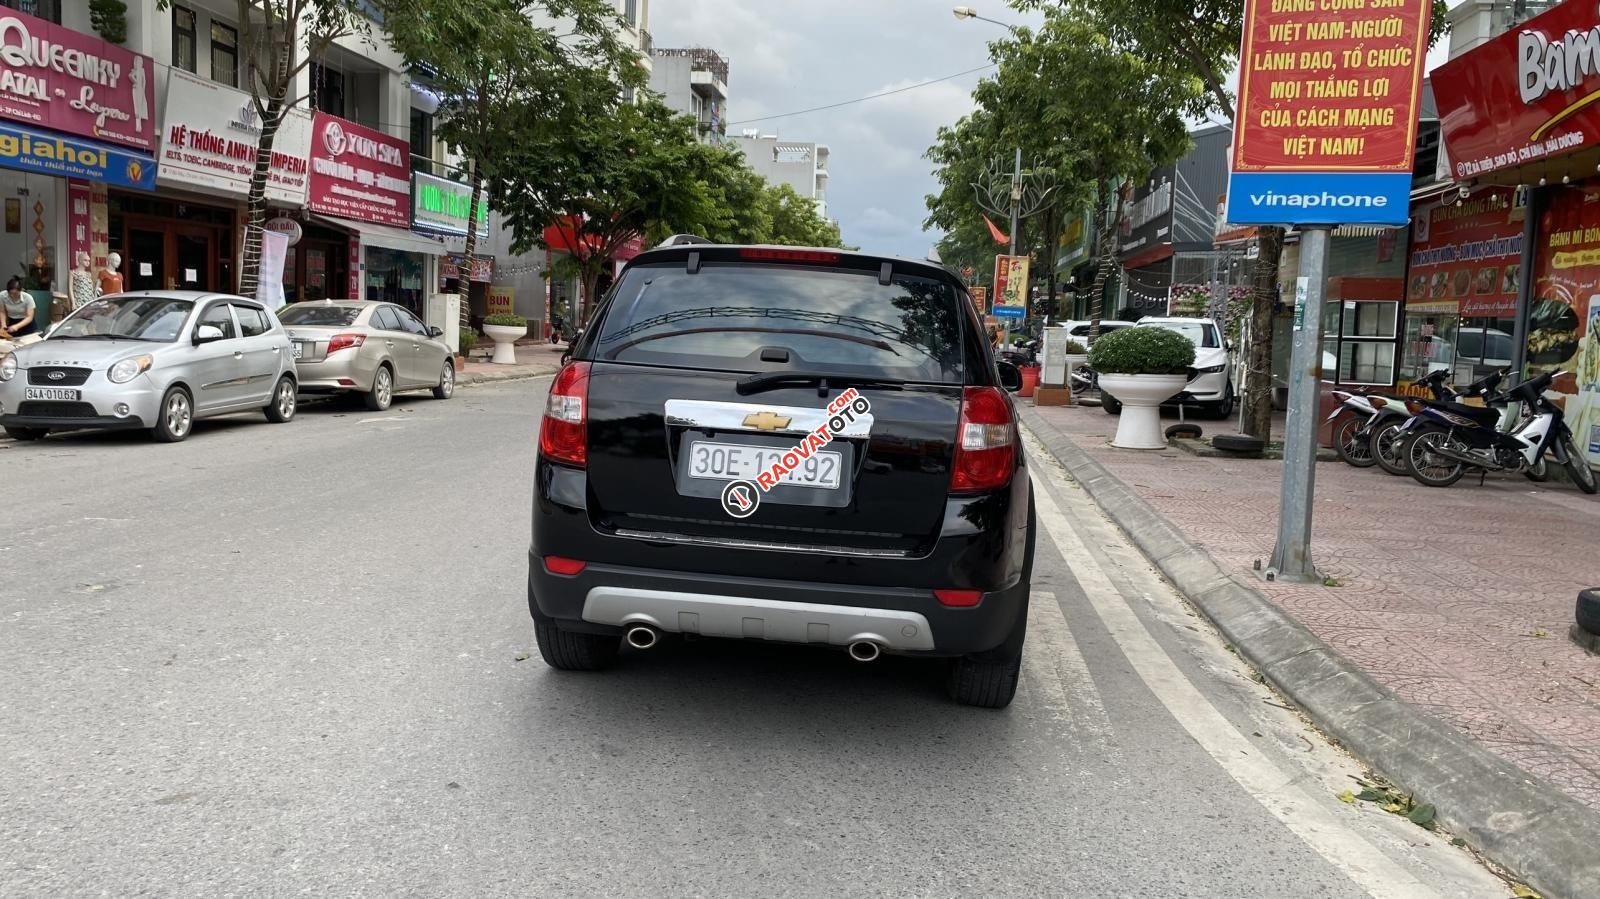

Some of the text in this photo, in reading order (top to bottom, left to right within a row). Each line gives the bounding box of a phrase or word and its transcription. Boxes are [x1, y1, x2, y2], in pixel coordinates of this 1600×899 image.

[1269, 14, 1403, 44] VIỆT NAM-NGƯỜI
[1254, 42, 1413, 73] LÃNH ĐẠO, TỔ CHỨC
[1269, 74, 1390, 102] MỌI THẮNG LỢI
[1260, 103, 1394, 130] CỦA CÁCH MẠNG
[170, 125, 186, 149] HỆ
[189, 129, 225, 154] THỐNG
[226, 141, 248, 161] ANH
[271, 151, 307, 175] IMPERIA
[346, 133, 403, 167] YUN SPA
[1283, 135, 1365, 159] VIỆT NAM!
[1250, 190, 1388, 209] vinaphone
[695, 447, 835, 484] 30E-1.92
